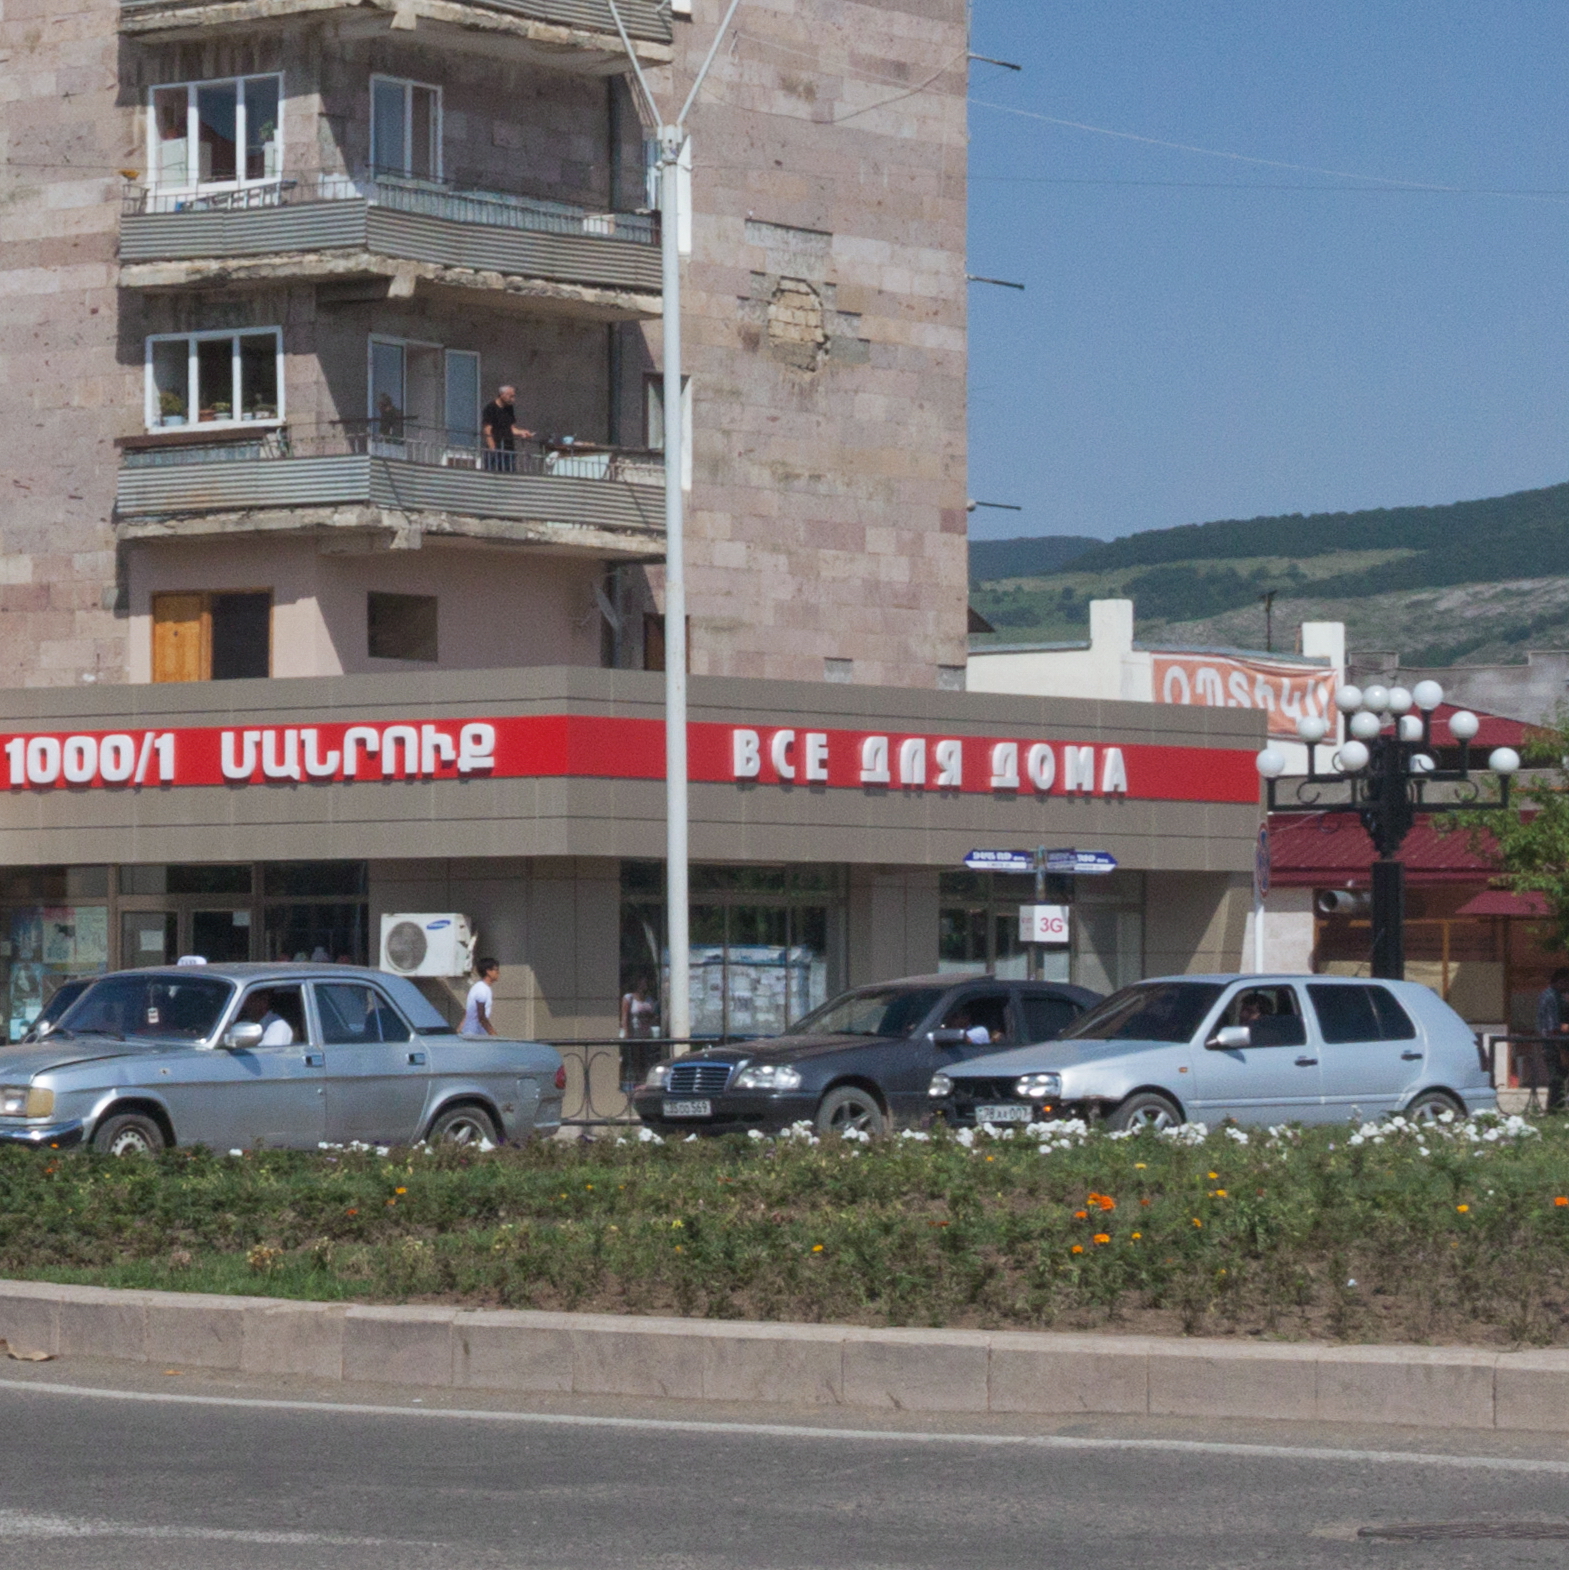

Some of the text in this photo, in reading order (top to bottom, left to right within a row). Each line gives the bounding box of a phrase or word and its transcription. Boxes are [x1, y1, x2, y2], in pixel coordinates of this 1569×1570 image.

[5, 722, 496, 785] 1000/1 ՄԱՆՐՈՒՔ
[732, 729, 1128, 793] ВСЕ ДЛЯ ДОМА
[1040, 917, 1063, 933] 3G
